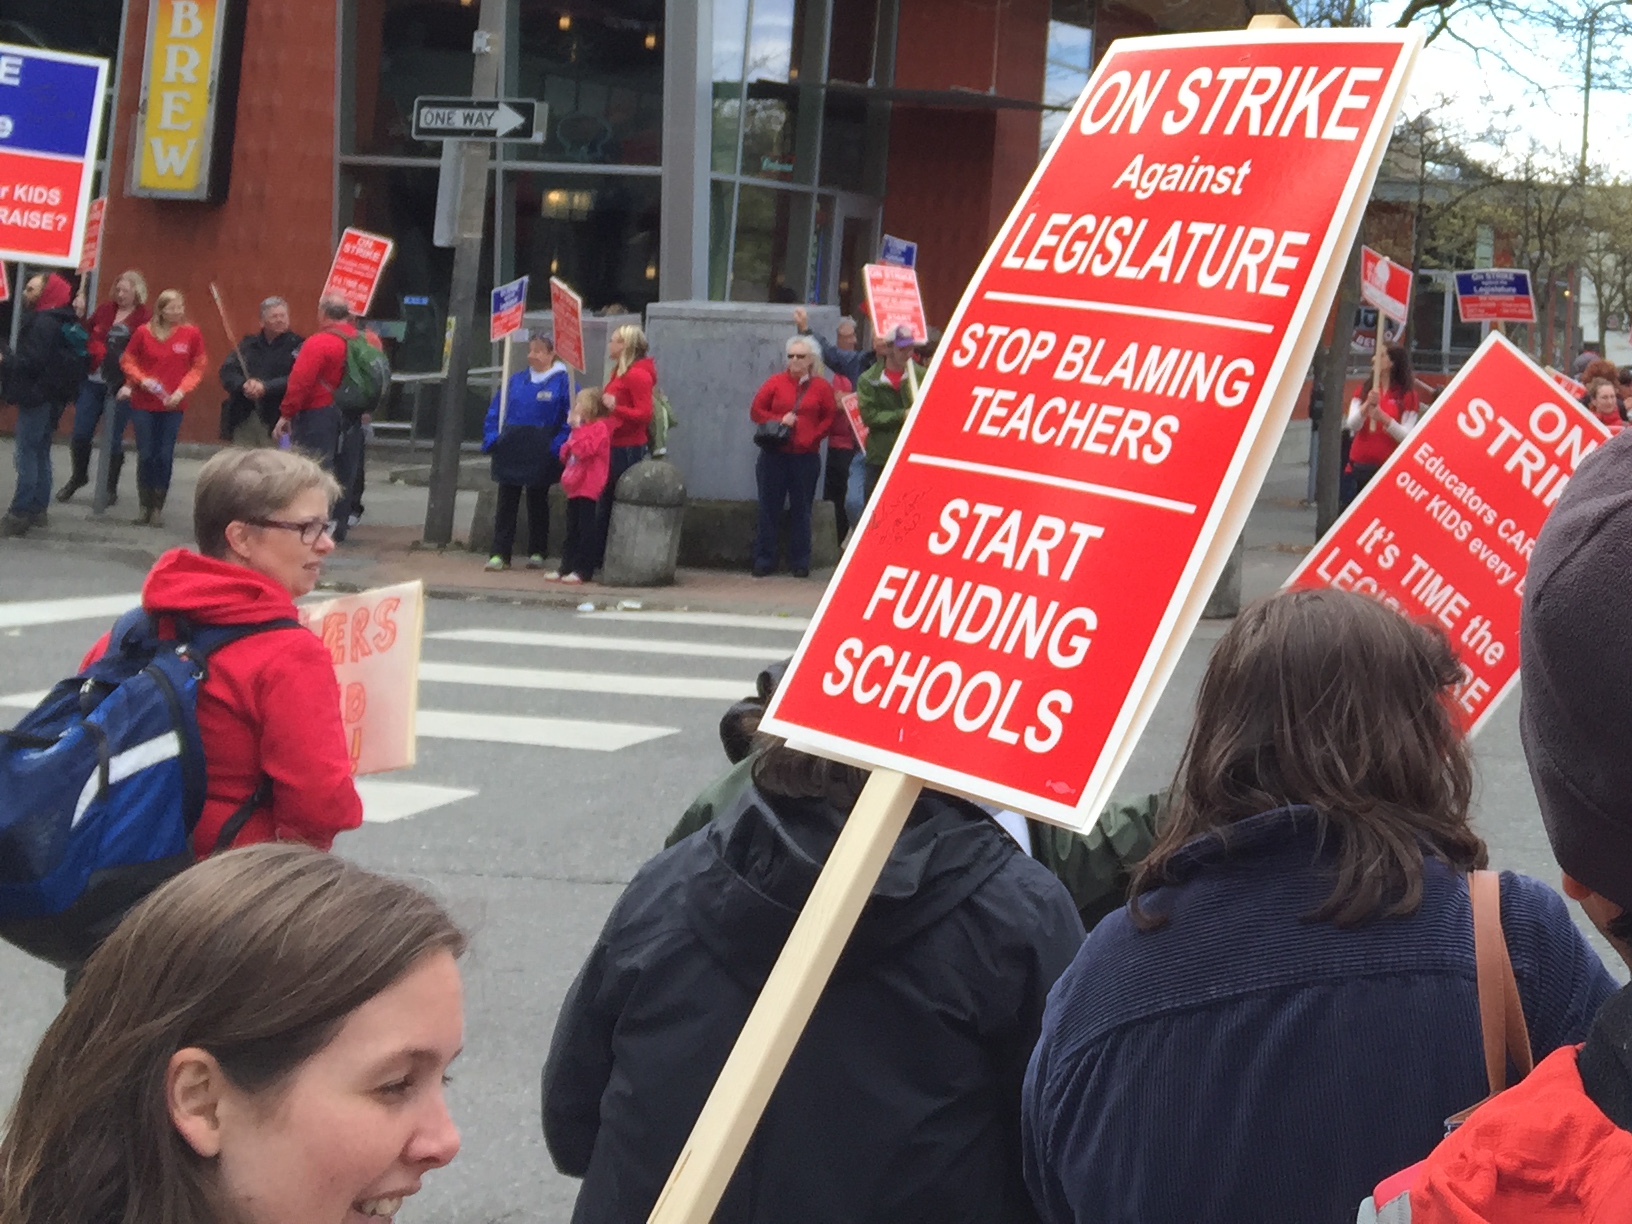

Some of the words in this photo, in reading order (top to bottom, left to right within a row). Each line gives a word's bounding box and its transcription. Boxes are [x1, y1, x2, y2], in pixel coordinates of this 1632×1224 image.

[150, 0, 202, 176] BREW
[424, 110, 457, 126] ONE
[462, 109, 496, 127] WAY
[1080, 67, 1156, 137] ON
[1161, 66, 1383, 141] STRIKE
[13, 182, 62, 207] KIDS
[1112, 154, 1251, 200] Against
[1003, 213, 1310, 297] LEGISLATURE
[952, 323, 1056, 374] STOP
[1053, 335, 1254, 407] BLAMING
[963, 386, 1179, 465] TEACHERS
[1529, 403, 1598, 472] ON
[1413, 442, 1498, 525] Educators
[928, 498, 1104, 582] START
[1396, 471, 1430, 502] our
[1425, 494, 1473, 542] KIDS
[1468, 537, 1517, 585] every
[321, 596, 401, 665] ERS
[863, 565, 1097, 668] FUNDING
[1356, 517, 1400, 569] It's
[1400, 553, 1471, 629] TIME
[1460, 615, 1505, 666] the
[823, 637, 1073, 753] SCHOOLS
